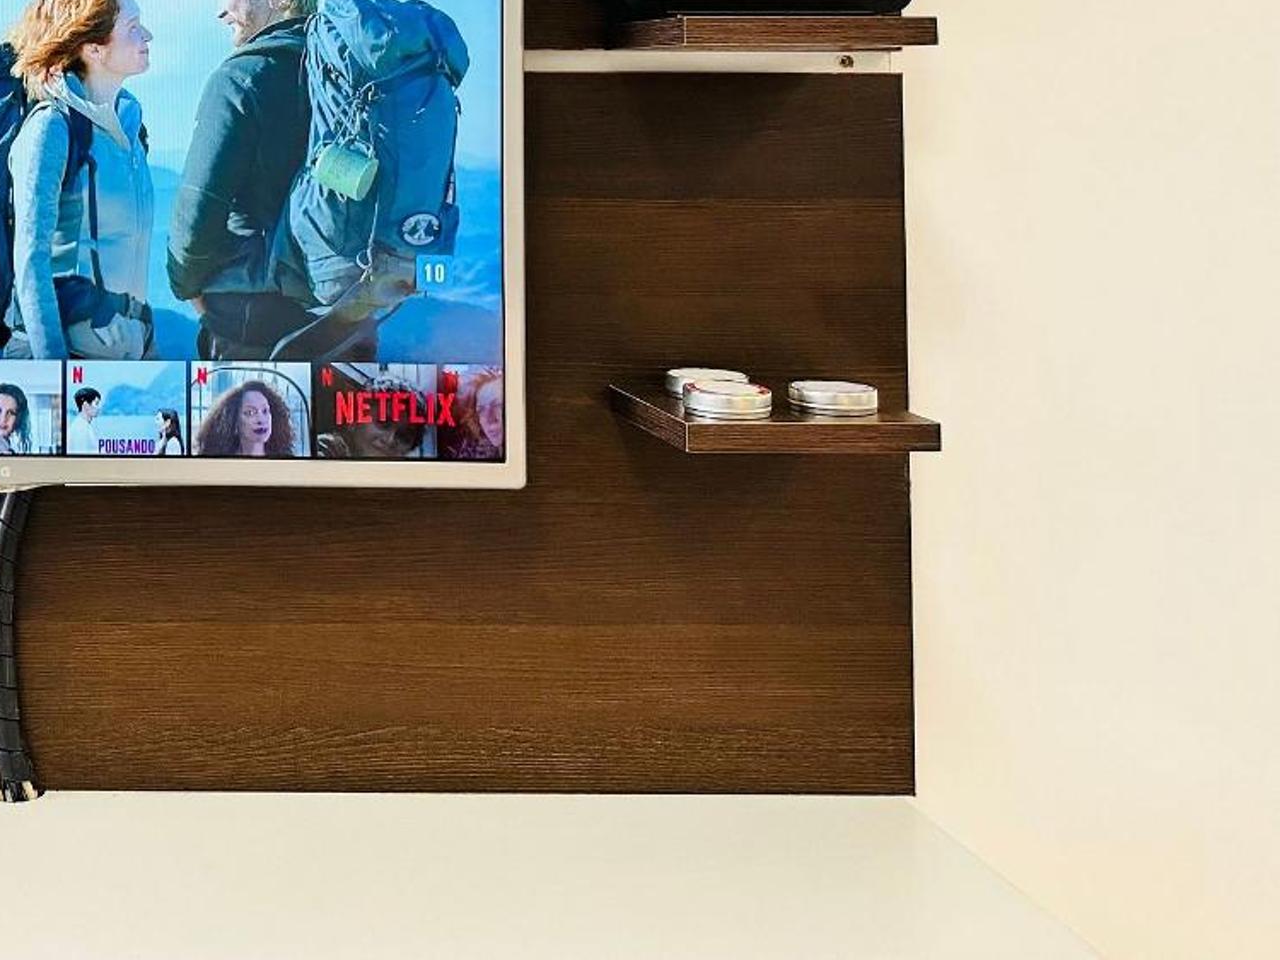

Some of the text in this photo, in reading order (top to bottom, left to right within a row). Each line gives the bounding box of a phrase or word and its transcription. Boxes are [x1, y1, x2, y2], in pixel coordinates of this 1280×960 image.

[425, 263, 445, 283] 10
[73, 366, 83, 383] N
[197, 368, 207, 384] N
[335, 391, 456, 426] NETFLIX
[98, 439, 155, 453] POUSANDO
